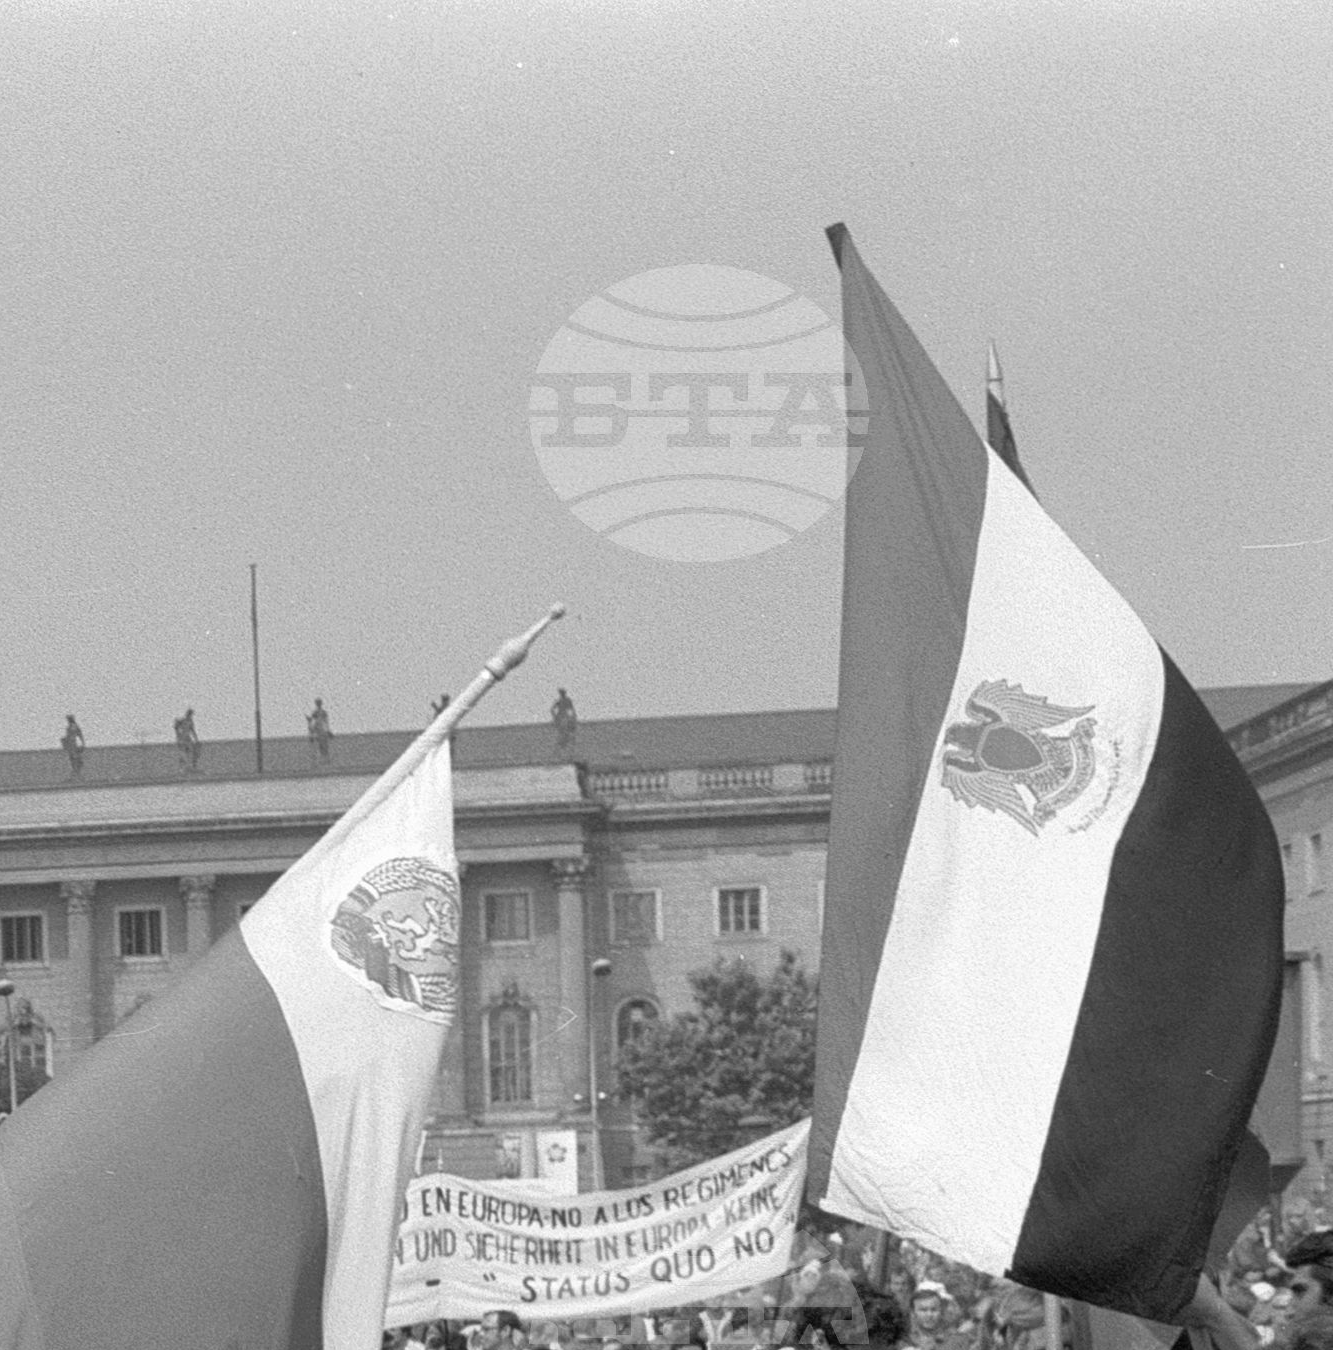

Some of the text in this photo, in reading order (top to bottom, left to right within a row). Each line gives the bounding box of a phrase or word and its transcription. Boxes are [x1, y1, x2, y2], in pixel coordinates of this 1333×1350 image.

[421, 1187, 451, 1217] EN
[414, 1228, 456, 1262] UND
[465, 1230, 583, 1266] SICHERHEIT
[595, 1234, 619, 1262] IN
[625, 1213, 711, 1258] EUROPA
[650, 1244, 716, 1282] QUO
